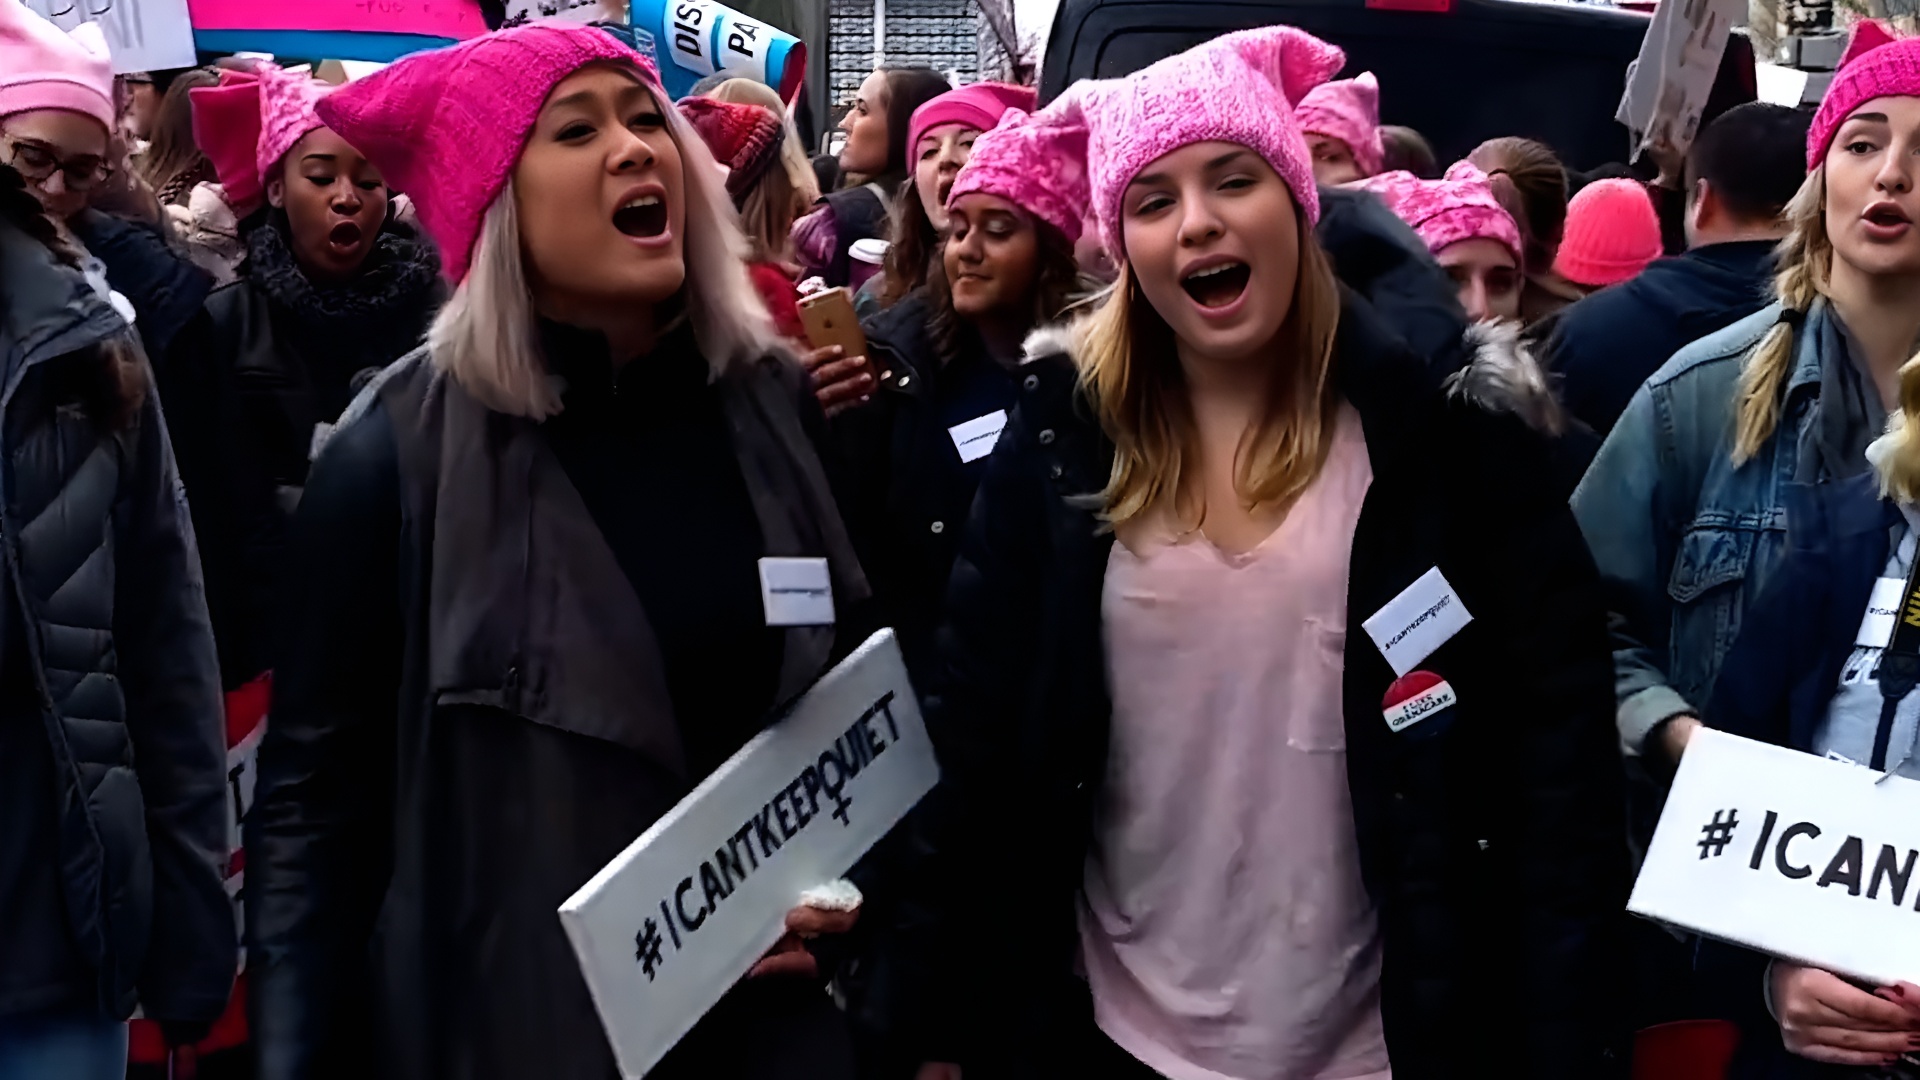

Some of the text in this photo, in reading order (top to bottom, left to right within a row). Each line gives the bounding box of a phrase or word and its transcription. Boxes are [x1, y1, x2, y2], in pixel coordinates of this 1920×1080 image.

[674, 0, 703, 57] DIS
[633, 689, 901, 984] #ICANTKEEPQUIET
[1697, 808, 1920, 913] #ICAN
